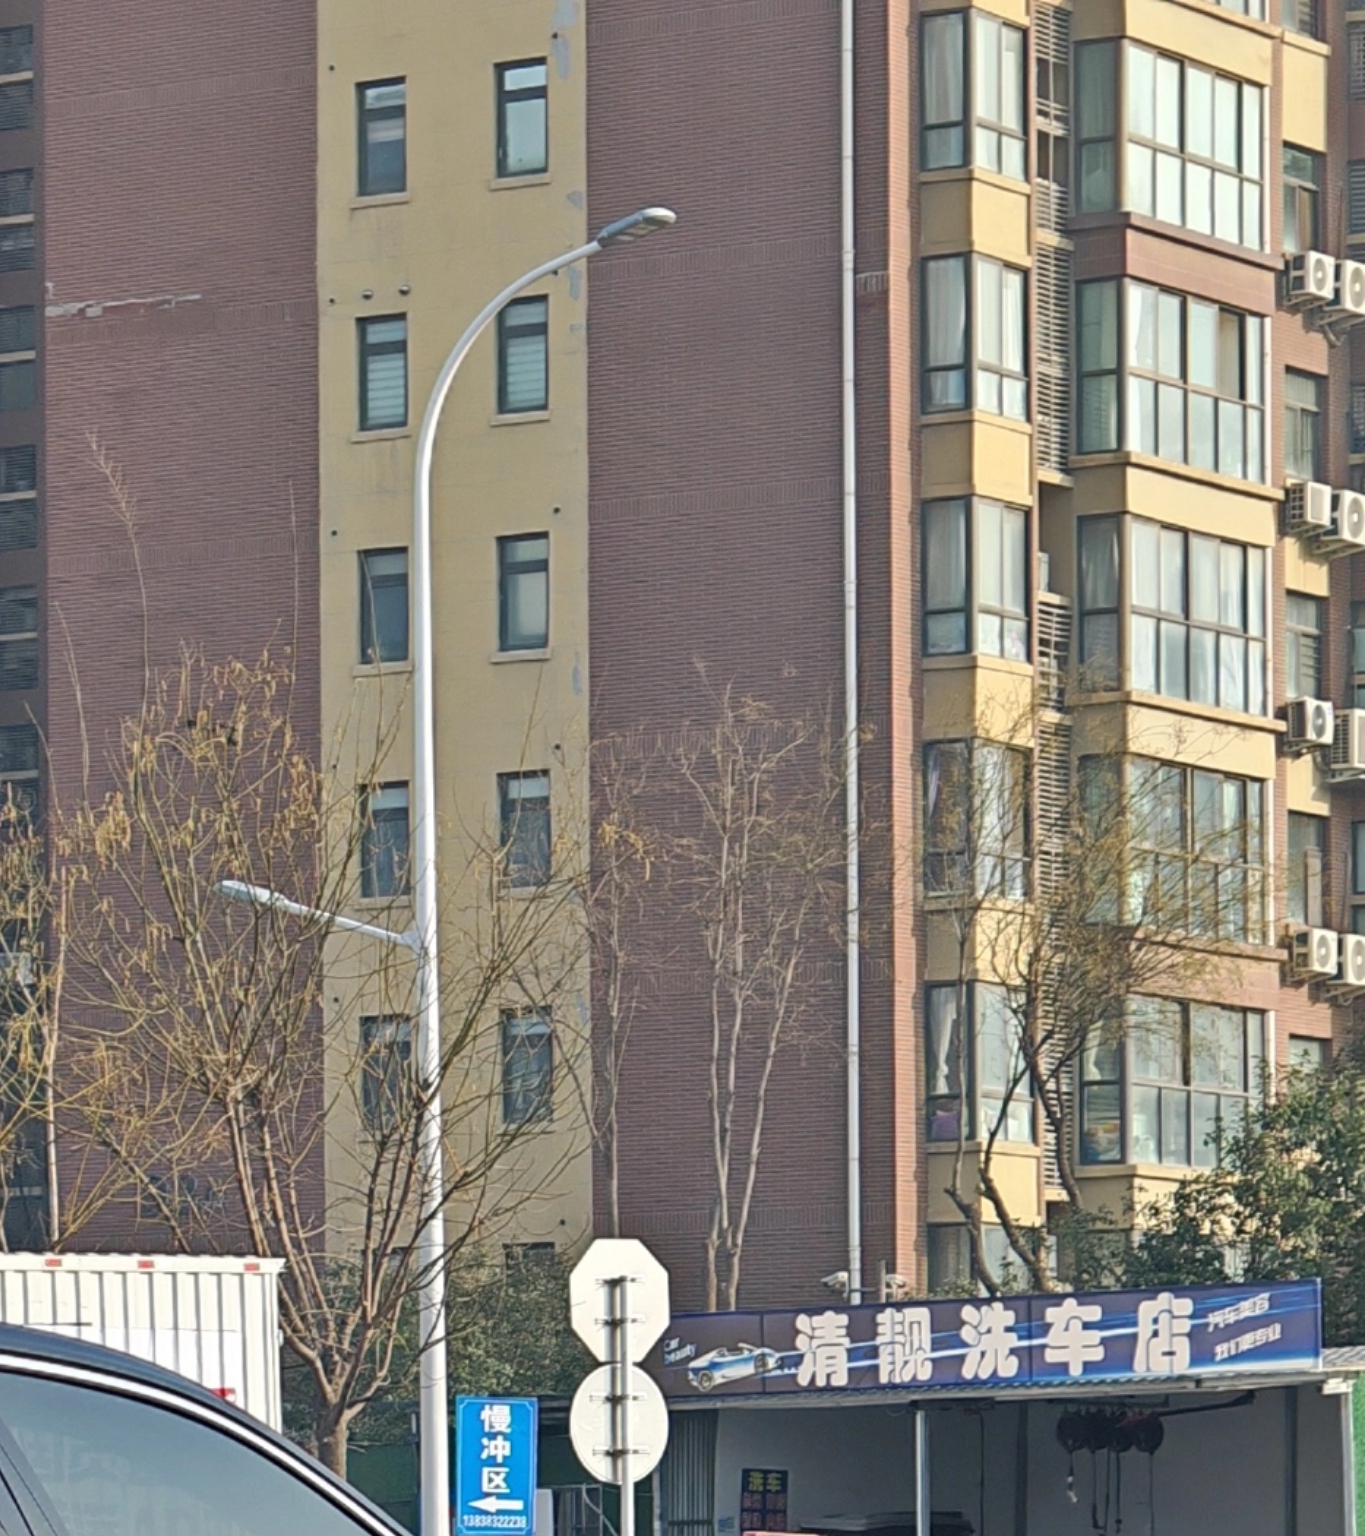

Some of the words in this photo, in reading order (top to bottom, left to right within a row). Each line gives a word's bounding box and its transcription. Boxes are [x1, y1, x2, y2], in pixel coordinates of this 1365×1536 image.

[795, 1292, 1194, 1387] 清靓洗车店
[480, 1404, 512, 1493] 慢冲区
